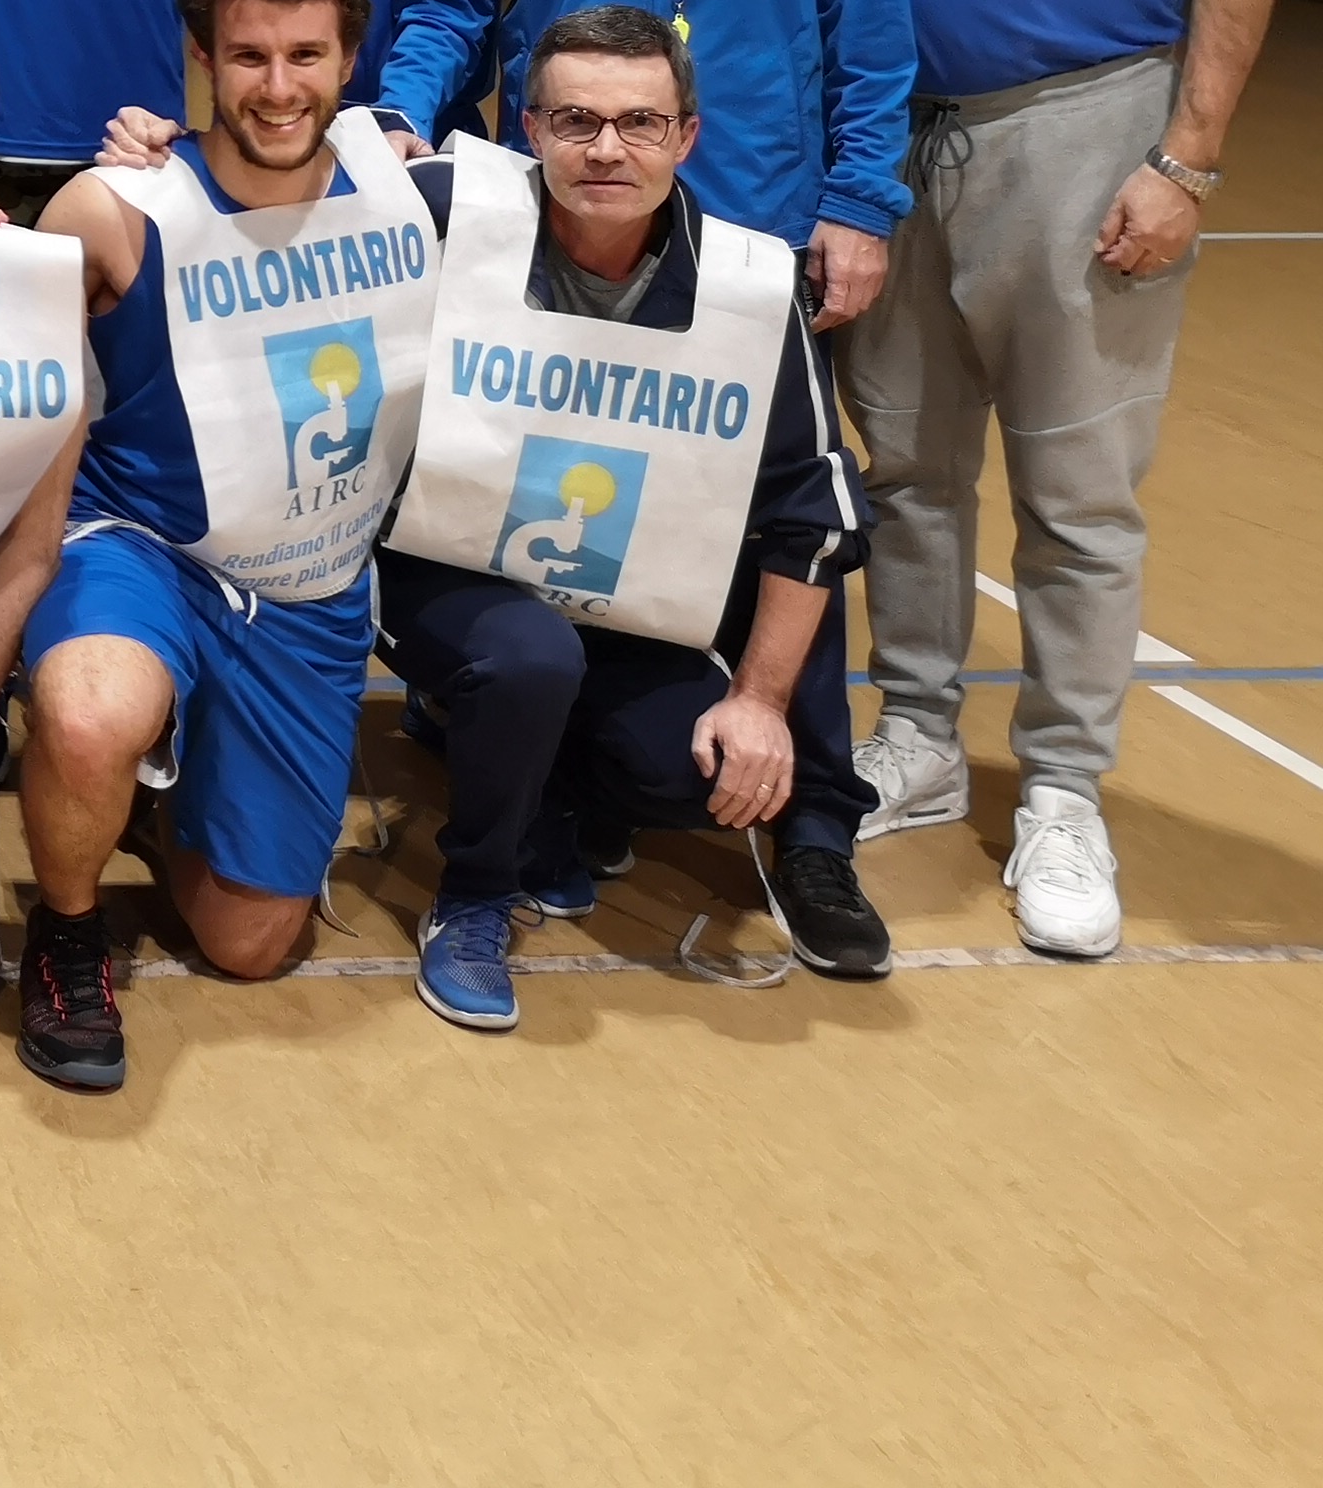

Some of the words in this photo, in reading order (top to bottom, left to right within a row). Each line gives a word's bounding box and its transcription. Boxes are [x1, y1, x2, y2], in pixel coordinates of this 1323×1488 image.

[178, 222, 425, 323] VOLONTARIO
[452, 338, 749, 440] VOLONTARIO
[283, 466, 366, 520] AIRC
[221, 534, 325, 569] Rendiamo
[295, 558, 327, 588] più
